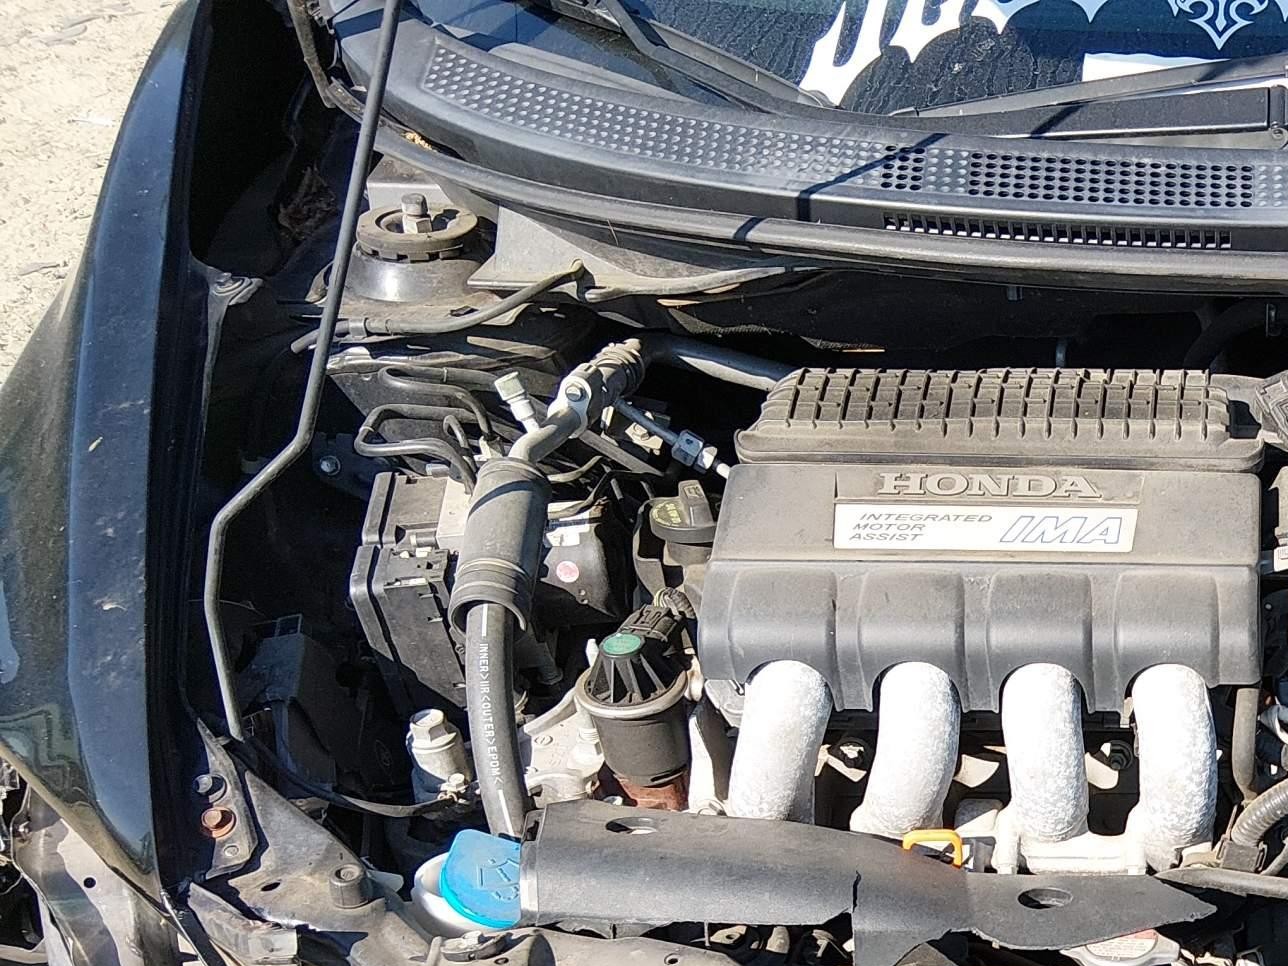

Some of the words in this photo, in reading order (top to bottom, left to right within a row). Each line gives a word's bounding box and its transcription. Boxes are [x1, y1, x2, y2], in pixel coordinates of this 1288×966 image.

[876, 472, 1103, 498] HONDA
[859, 513, 993, 523] INTEGRATED
[852, 523, 926, 532] MOTOR
[999, 515, 1123, 544] IMA
[849, 533, 924, 541] ASSIST
